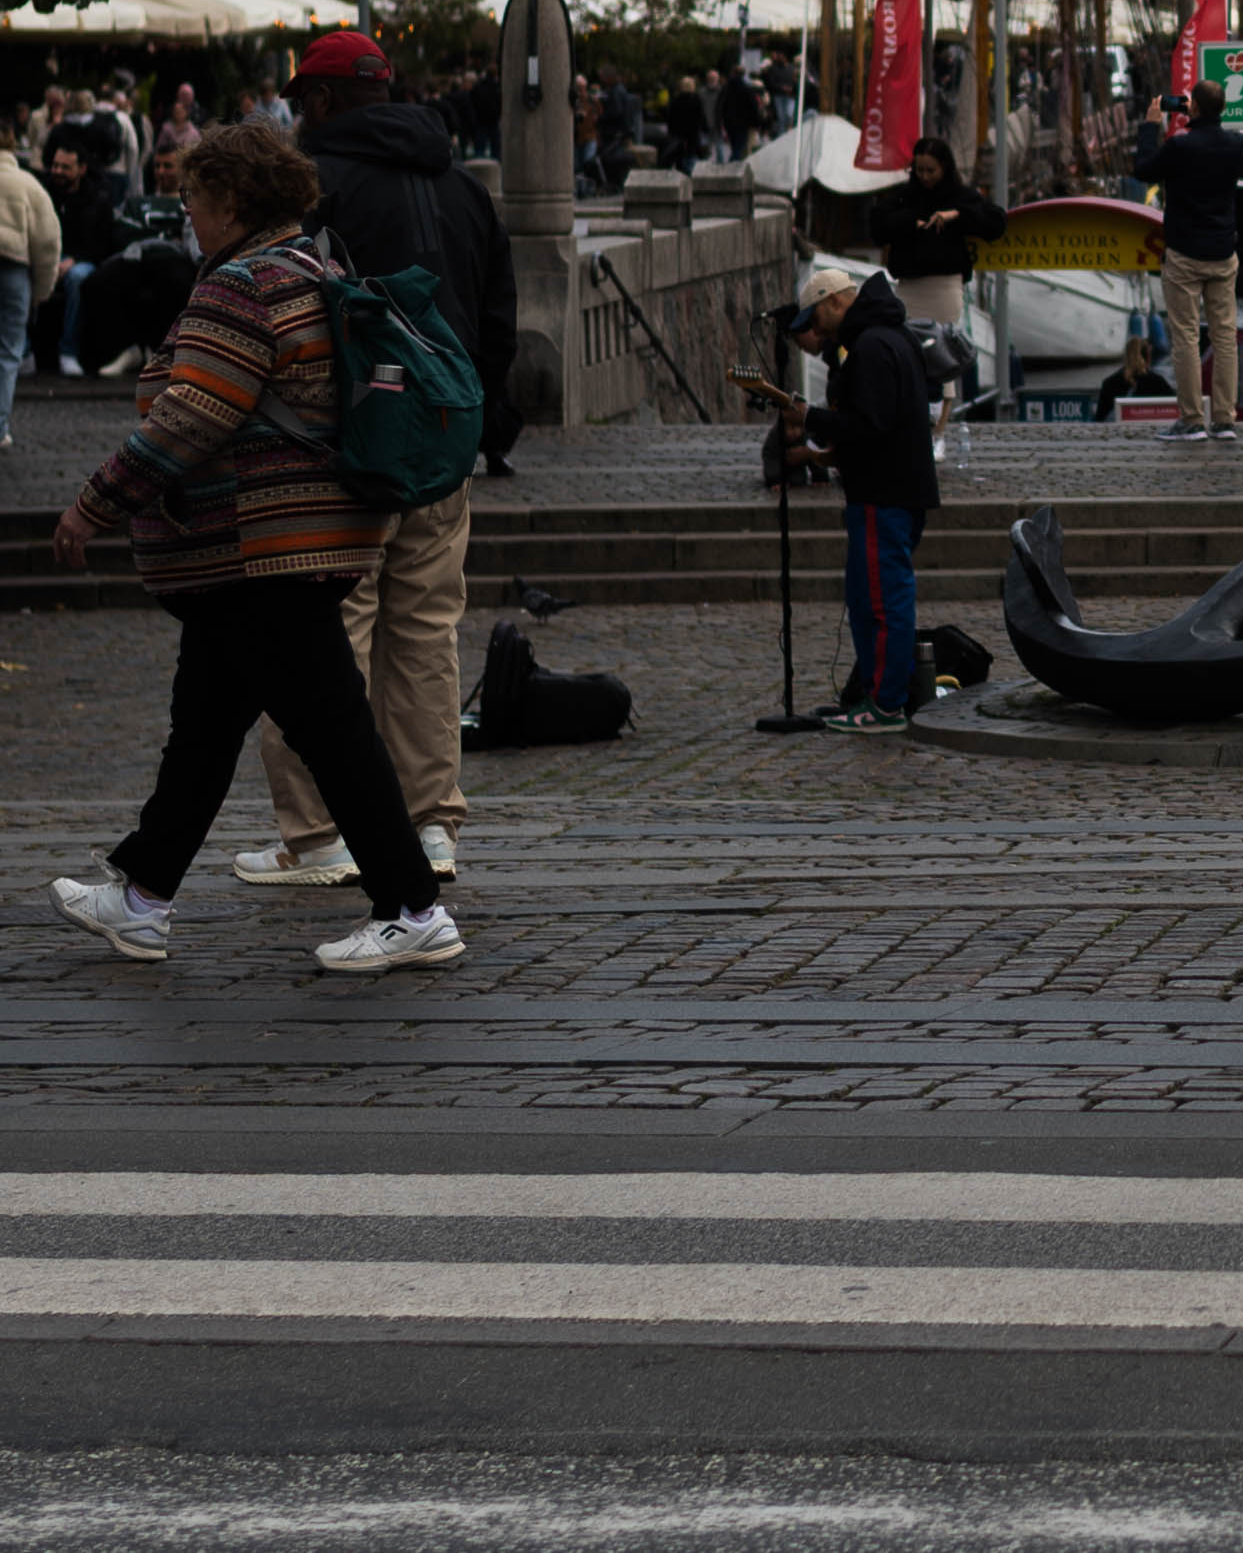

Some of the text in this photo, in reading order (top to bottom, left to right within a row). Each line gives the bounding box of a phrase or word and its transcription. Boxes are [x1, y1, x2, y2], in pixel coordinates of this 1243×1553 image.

[1059, 234, 1119, 247] TOURS
[986, 252, 1122, 265] COPENHAGEN
[1051, 401, 1082, 418] LOOK
